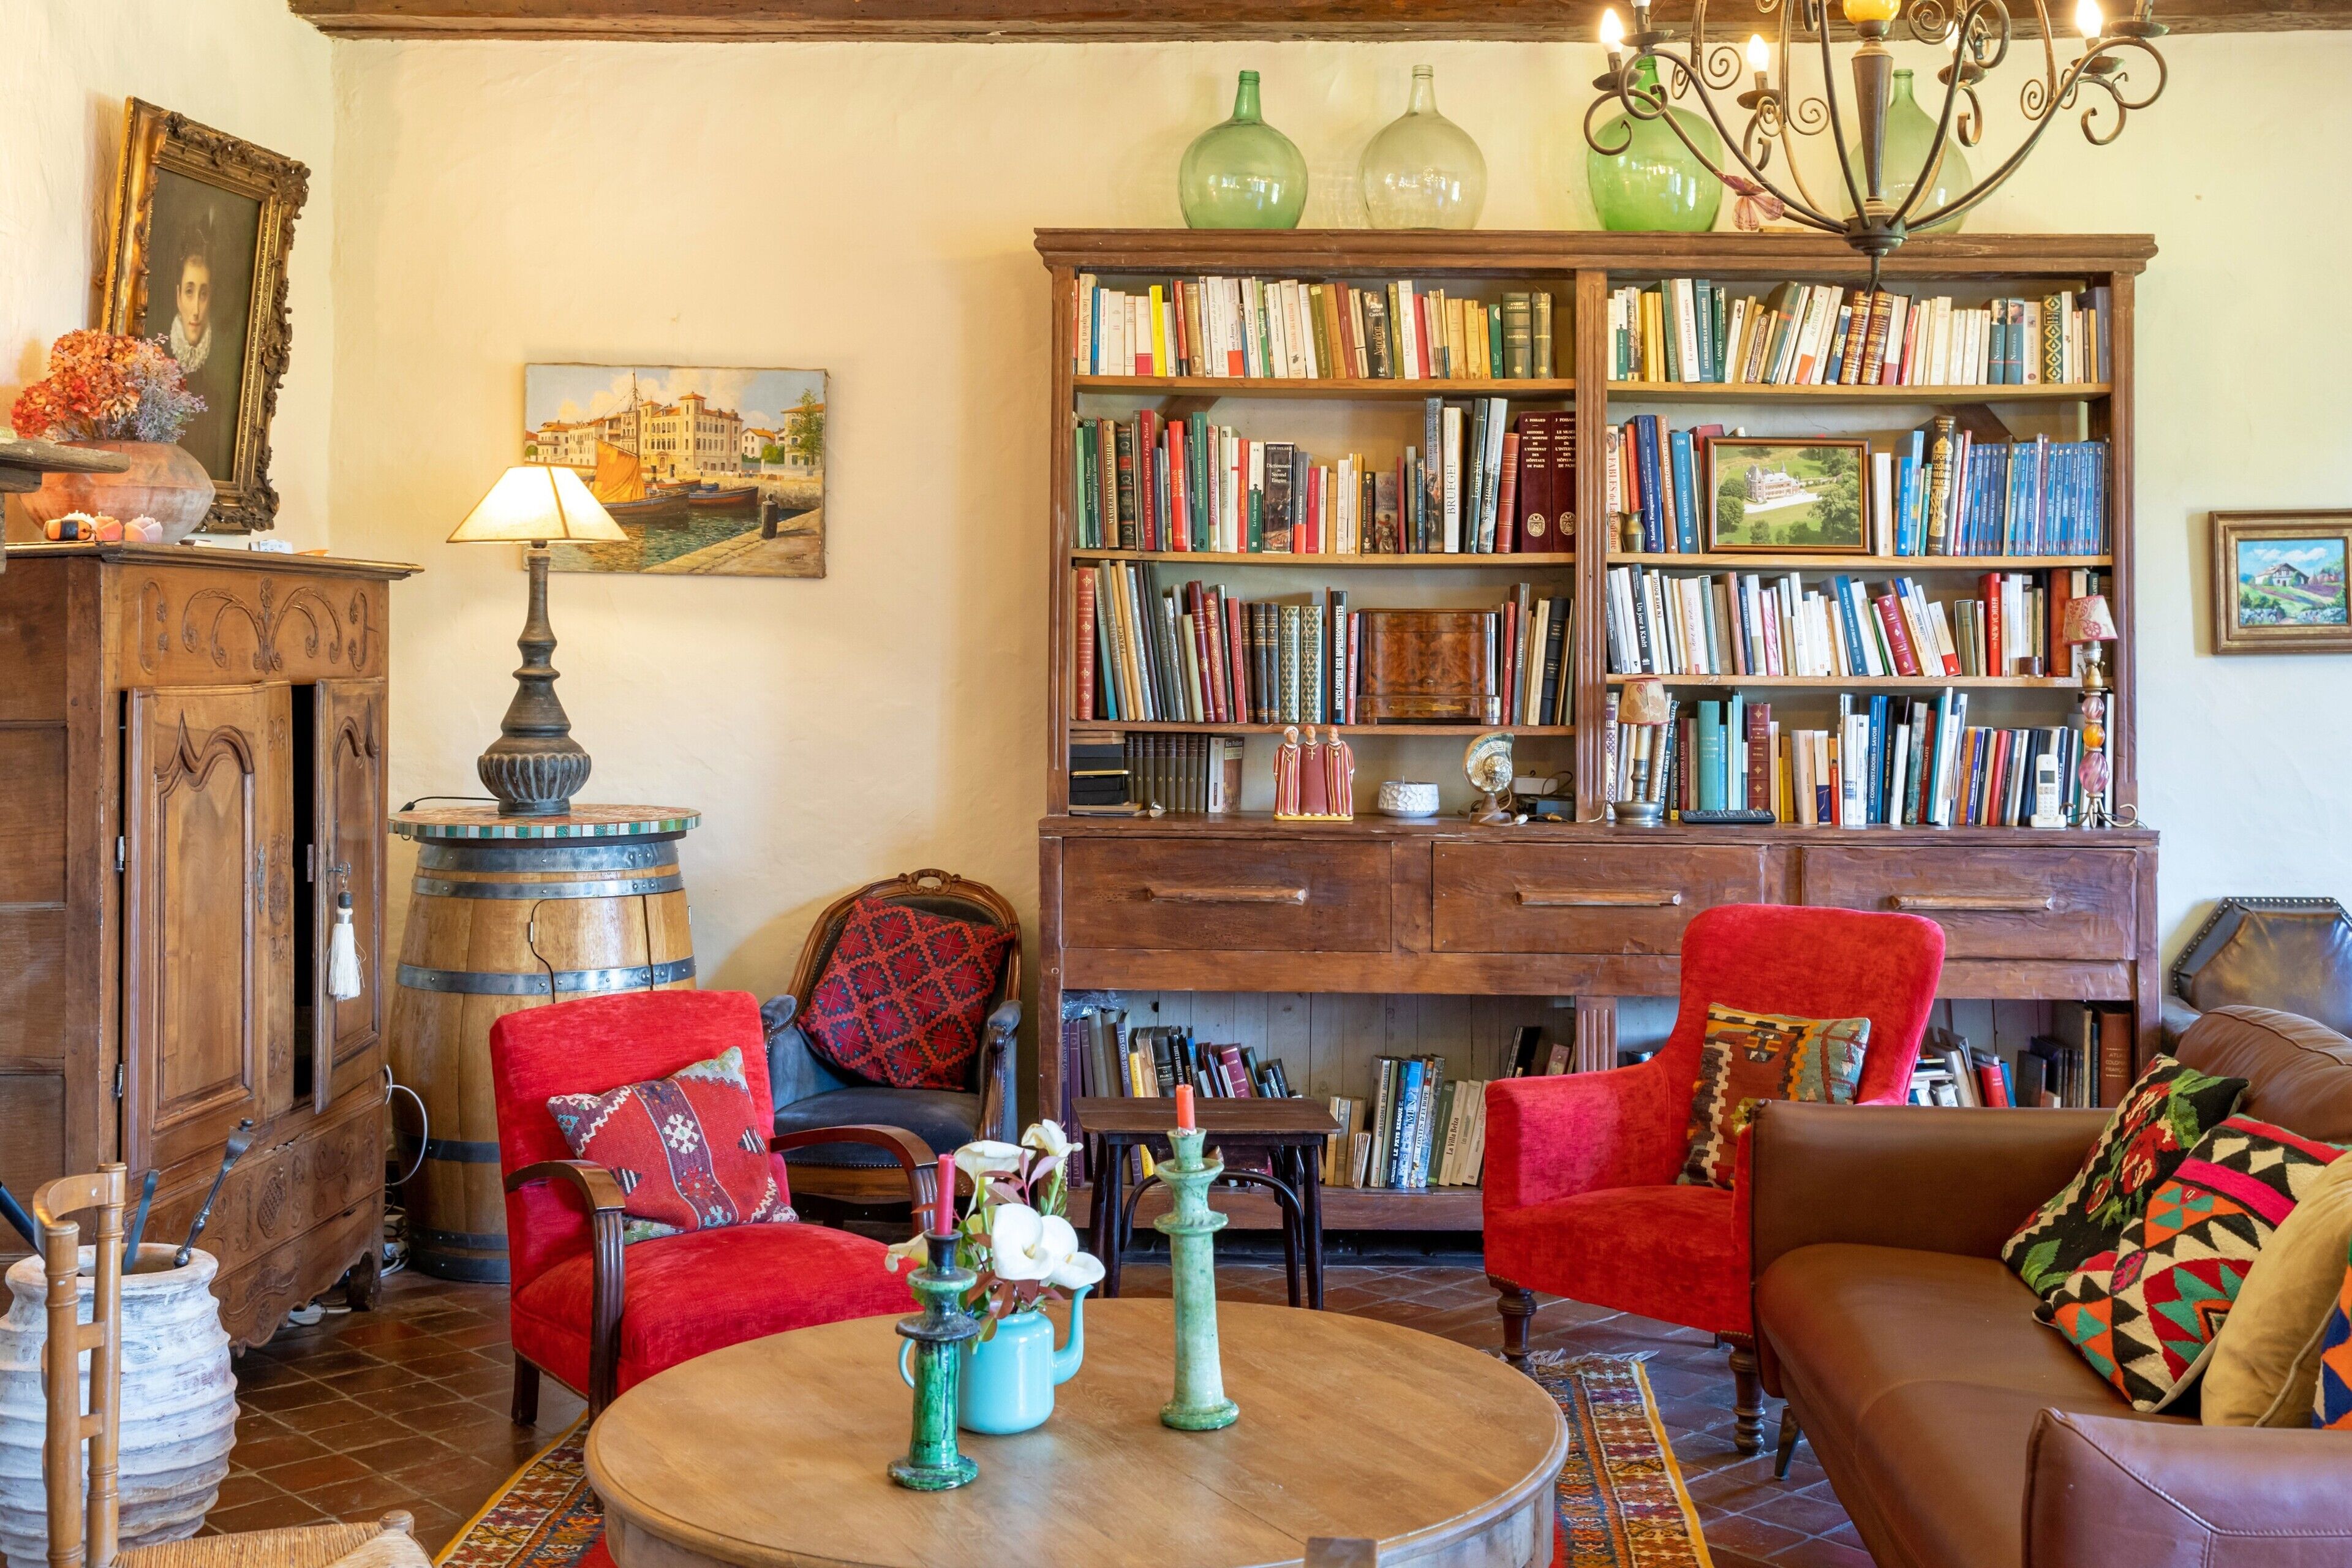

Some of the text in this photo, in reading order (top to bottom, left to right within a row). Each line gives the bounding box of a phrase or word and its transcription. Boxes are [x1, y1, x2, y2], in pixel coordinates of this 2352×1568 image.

[1811, 301, 1823, 336] AUSTERLITZ
[1373, 326, 1384, 356] Napoléon
[1447, 461, 1456, 514] BRUEGEL
[1471, 475, 1480, 497] Louis
[1608, 458, 1617, 492] FABLES
[1610, 502, 1618, 513] La
[1637, 603, 1643, 611] Un
[1335, 605, 1344, 657] IMPRESSIONNISTES
[1335, 670, 1343, 710] ENCYCLOPEDIE
[1380, 1093, 1387, 1102] DU
[1378, 1105, 1386, 1137] MAISONS
[1415, 1090, 1429, 1148] CONTES D'EUROPE
[1450, 1117, 1459, 1133] Belza
[1393, 1148, 1398, 1156] LE
[1448, 1134, 1457, 1147] Villa
